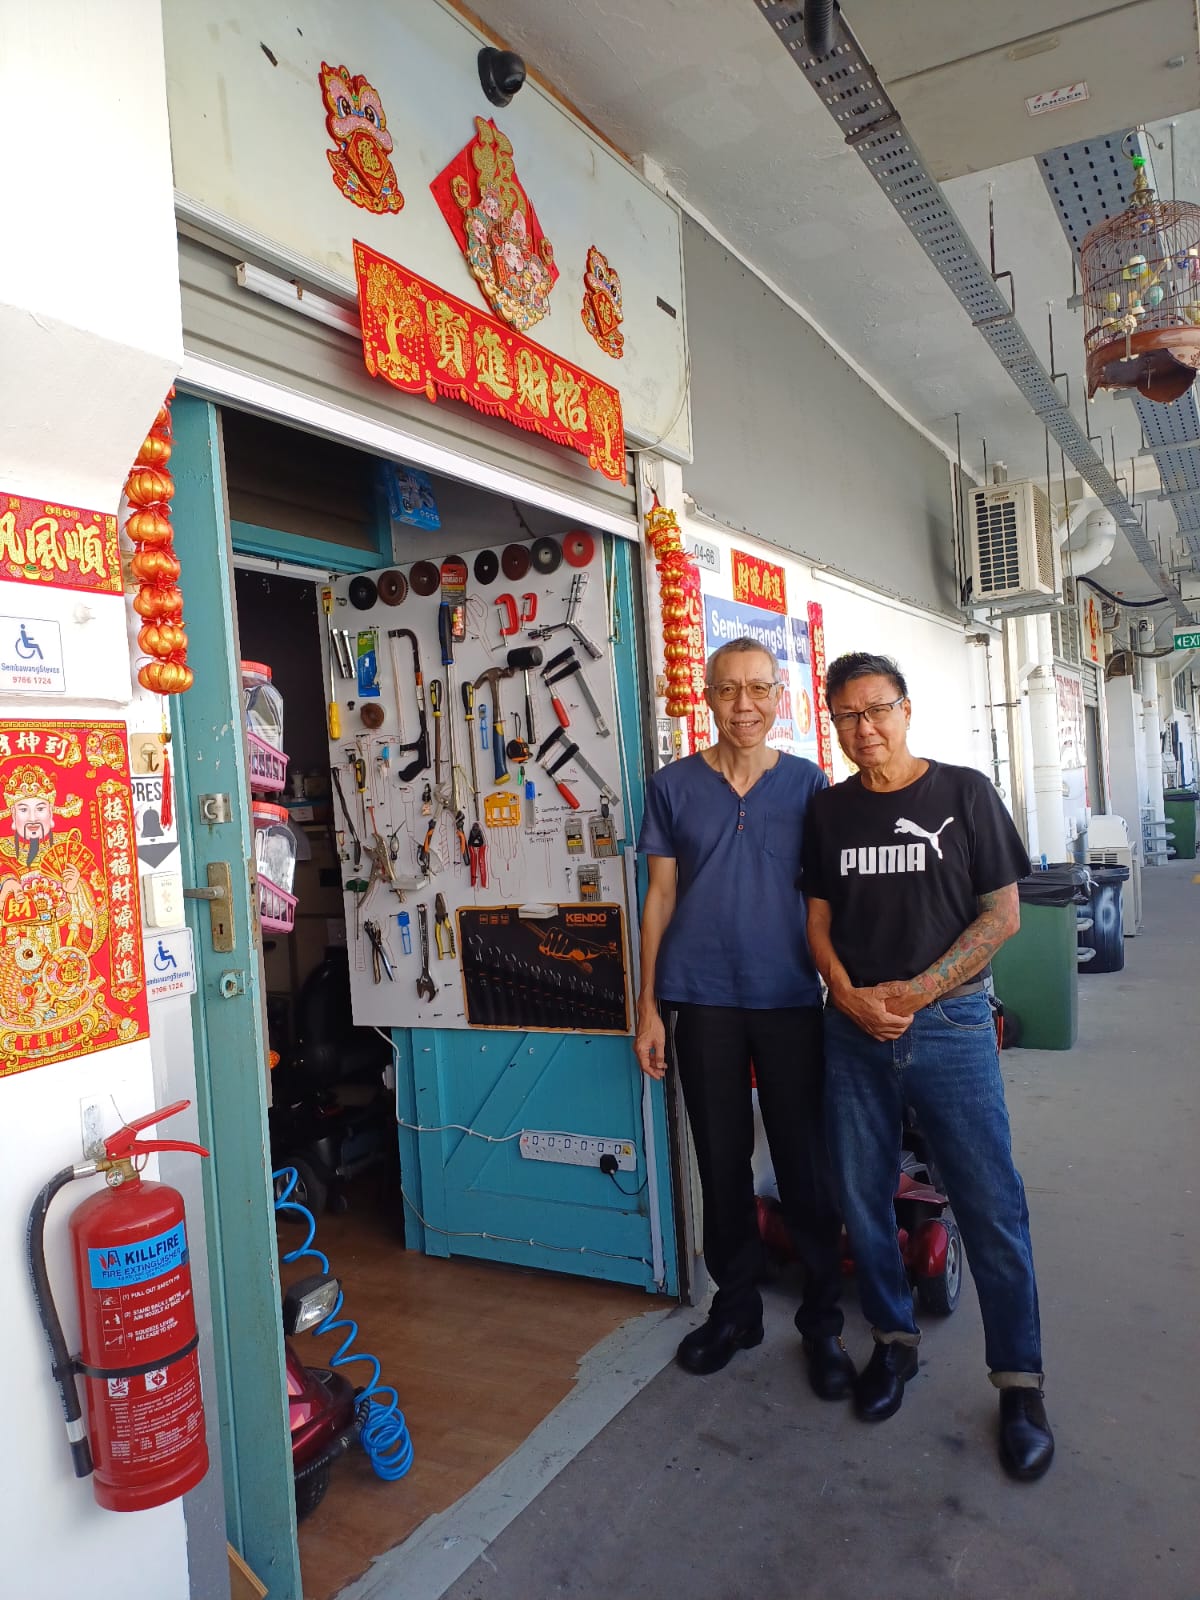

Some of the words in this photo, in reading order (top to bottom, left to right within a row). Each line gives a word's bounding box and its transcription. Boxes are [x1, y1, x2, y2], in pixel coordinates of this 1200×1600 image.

[1183, 634, 1200, 647] EXI
[131, 781, 162, 802] PRES
[840, 842, 926, 876] PUMA
[565, 913, 607, 923] KENDO
[124, 1233, 180, 1266] KILLFIRE
[102, 1268, 121, 1278] FIRE
[124, 1248, 181, 1275] EXTINGUISHER
[131, 1291, 145, 1299] PULL
[145, 1286, 156, 1295] OUT
